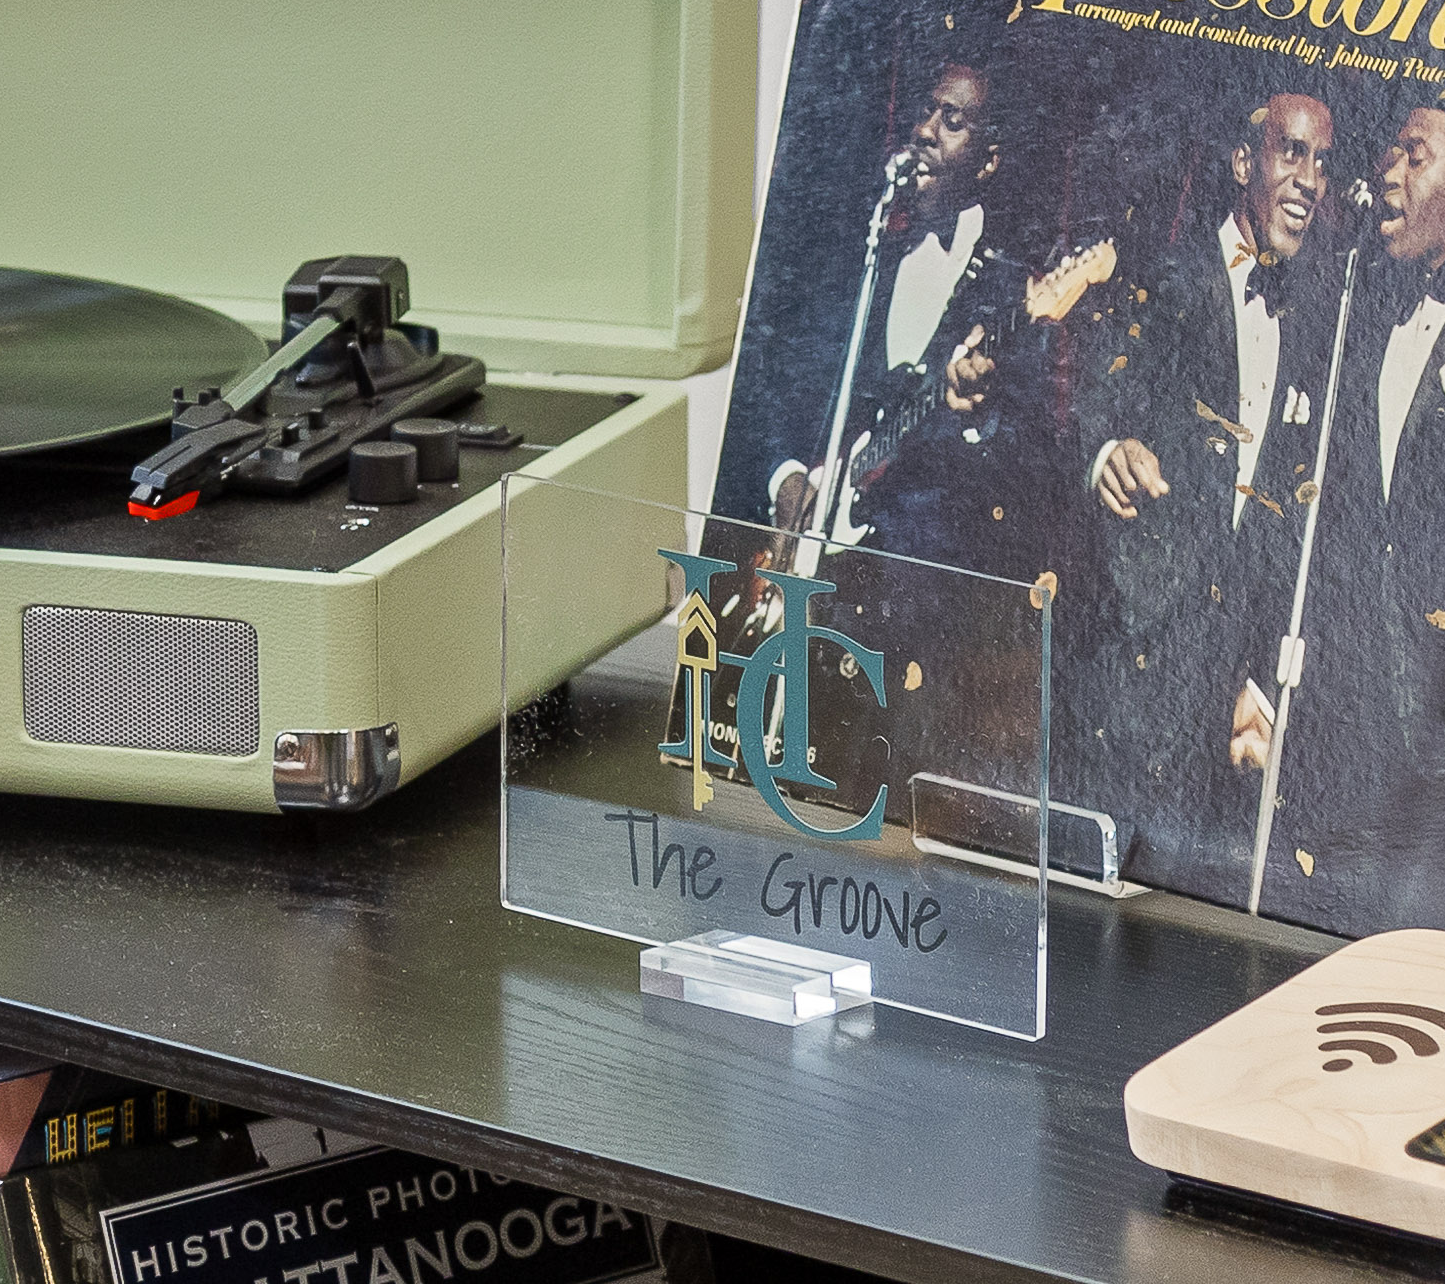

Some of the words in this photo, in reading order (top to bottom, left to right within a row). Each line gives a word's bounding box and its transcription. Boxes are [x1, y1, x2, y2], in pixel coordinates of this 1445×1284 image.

[1074, 2, 1160, 32] arranged
[1160, 17, 1199, 39] and
[1199, 25, 1295, 56] conducted
[1295, 36, 1326, 65] by:
[1325, 44, 1399, 81] Johnny
[605, 809, 723, 903] The
[760, 852, 948, 954] Groove
[131, 1198, 351, 1282] HISTORIC
